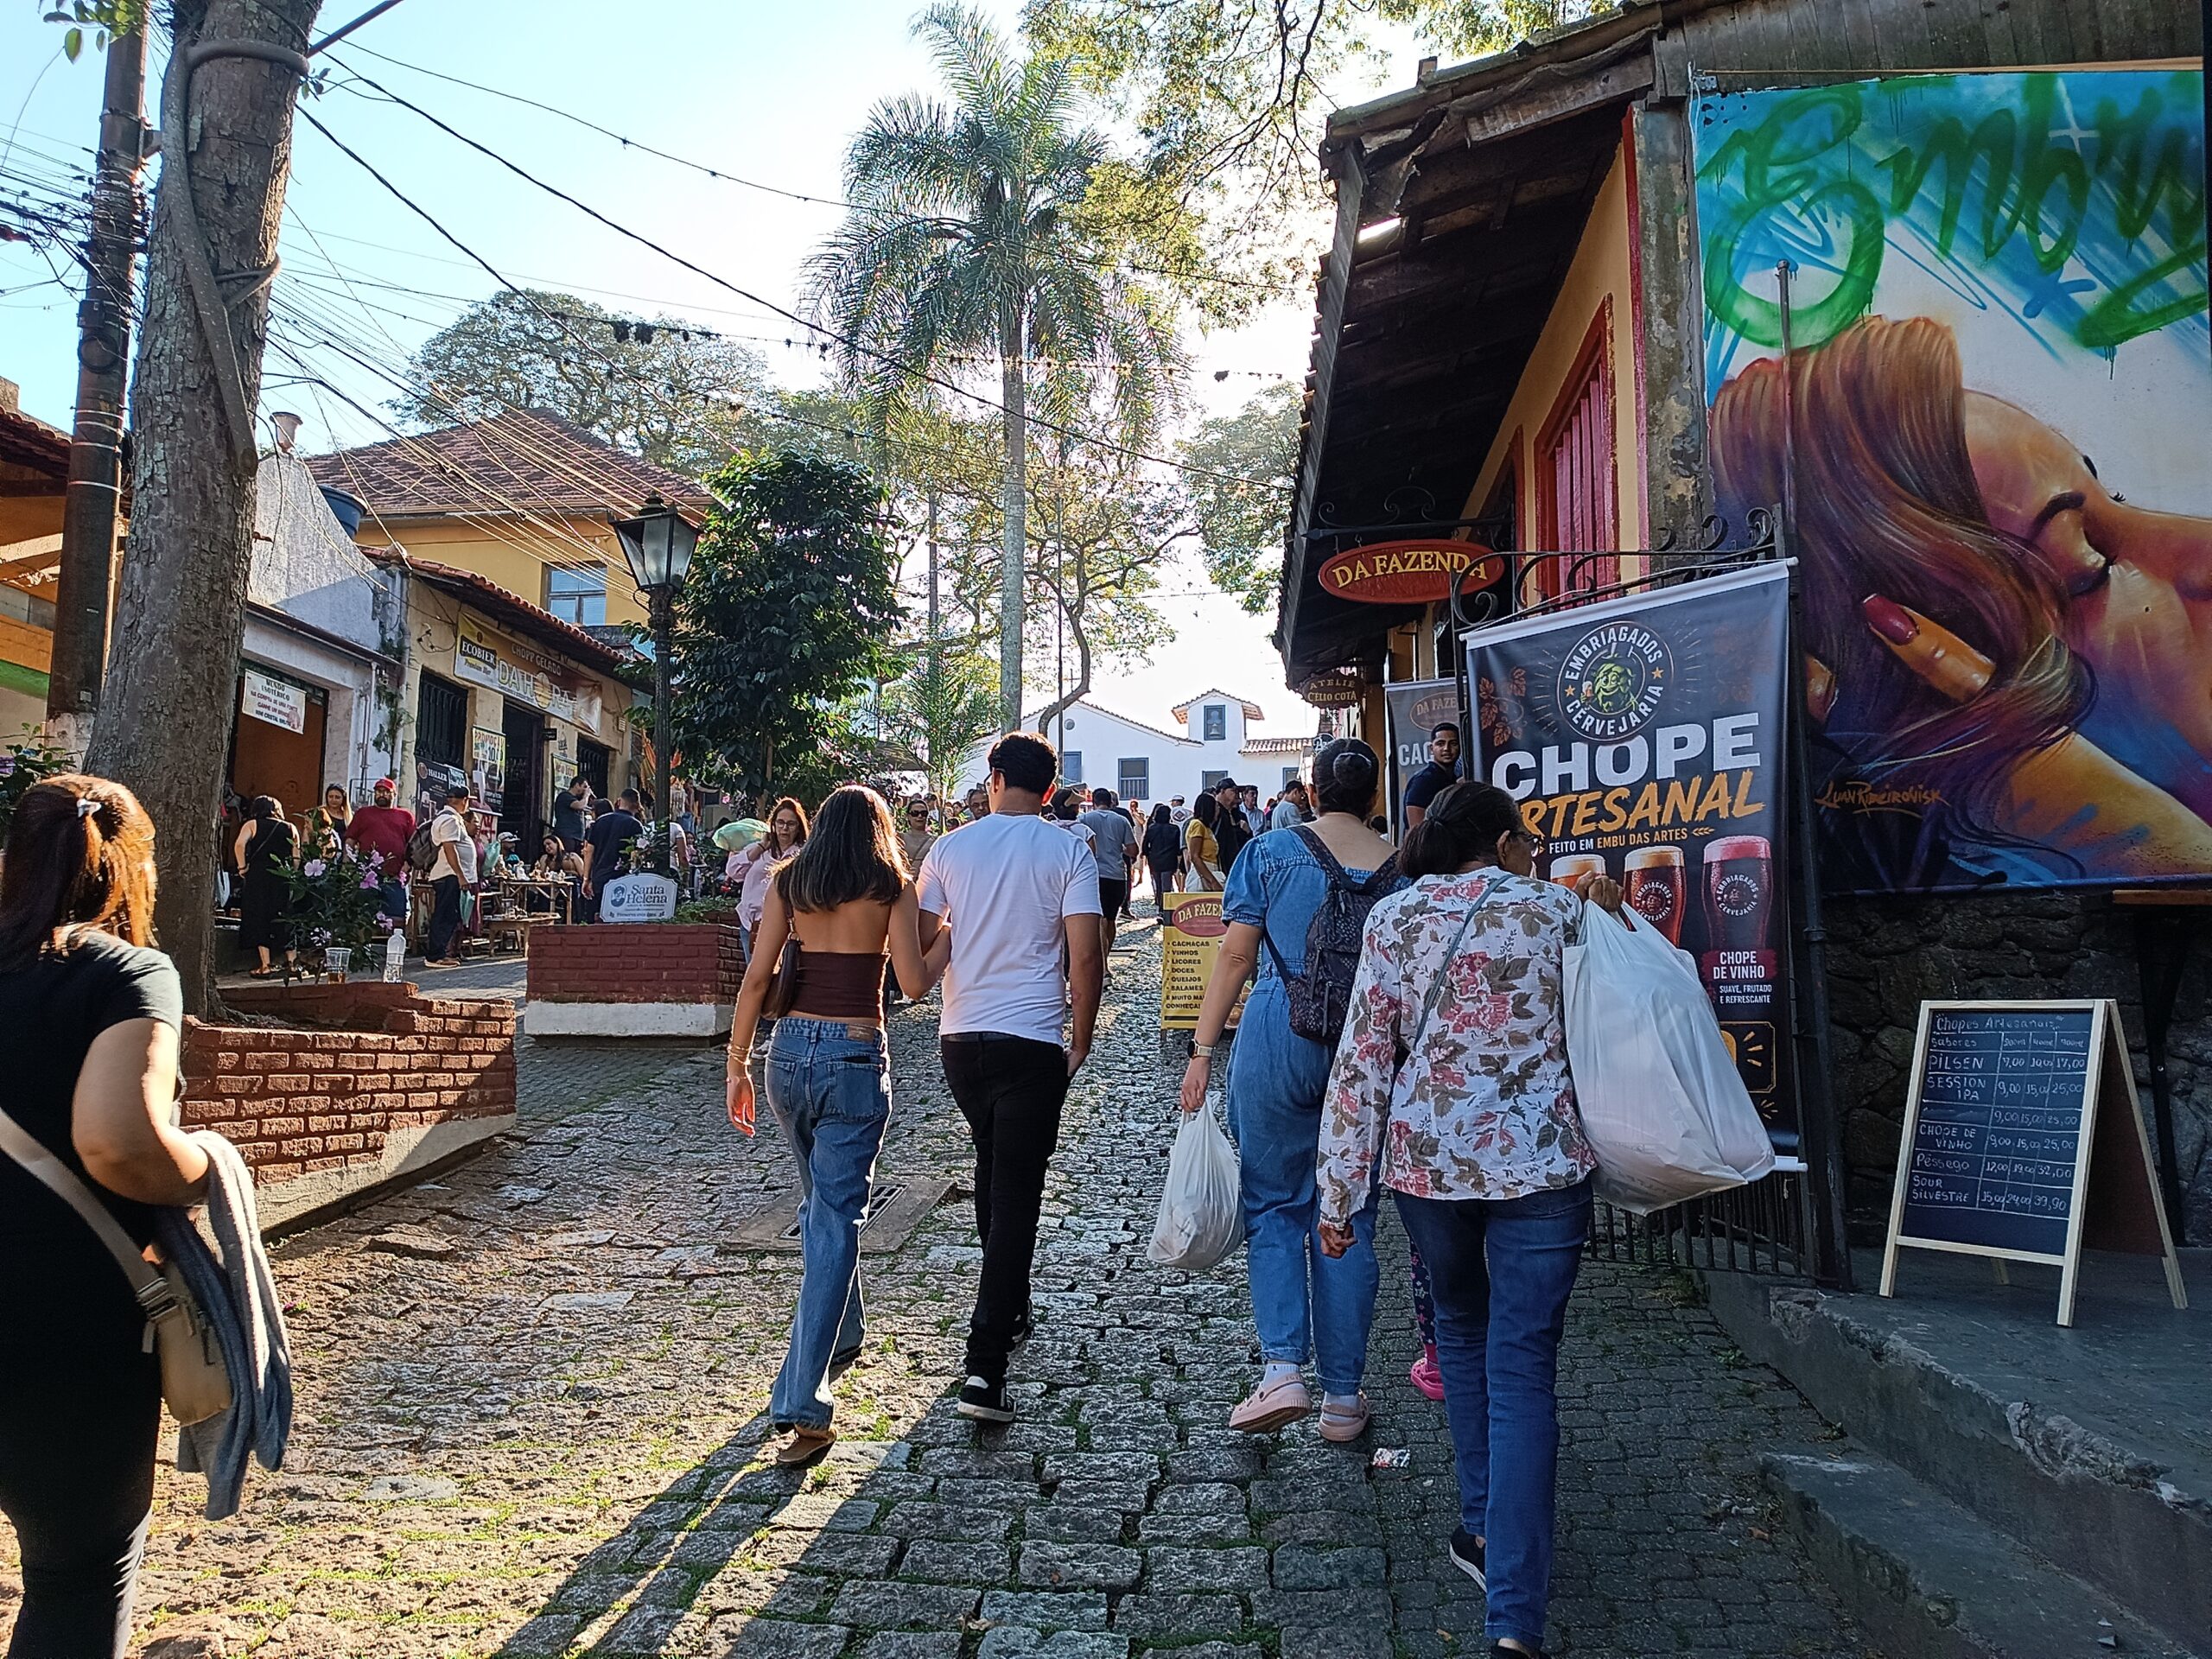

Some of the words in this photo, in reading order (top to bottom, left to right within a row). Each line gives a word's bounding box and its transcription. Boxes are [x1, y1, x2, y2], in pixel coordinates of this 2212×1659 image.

[1332, 560, 1372, 588] DA
[1373, 551, 1488, 580] FAZENDA
[462, 641, 496, 665] ECOBIER
[512, 644, 534, 663] CHOPP
[535, 655, 562, 677] GELADO
[1565, 626, 1663, 681] EMBRIAGADOS
[499, 659, 520, 691] DA
[1416, 702, 1429, 716] DA
[1566, 685, 1663, 735] CERVEJARIA
[1492, 713, 1761, 801] CHOPE
[1520, 769, 1766, 840] RTESANAL
[1549, 840, 1576, 855] FEITO
[1580, 838, 1594, 851] EM
[1597, 835, 1626, 849] EMBU
[1629, 832, 1650, 847] DAS
[1654, 828, 1688, 843] ARTES
[631, 884, 664, 894] Santa
[626, 893, 667, 904] Helena
[1179, 907, 1192, 924] DA
[1719, 951, 1757, 964] CHOPE
[1713, 966, 1727, 979] DE
[1730, 965, 1764, 979] VINHO
[1744, 984, 1772, 993] FRUTADO
[1726, 995, 1770, 1003] REFRESCANTE
[1936, 1016, 1979, 1033] Chopes
[1927, 1077, 1986, 1089] SESSION
[1998, 1082, 2021, 1097] 9,00
[1964, 1128, 1976, 1138] DE
[1990, 1135, 2012, 1147] 9,00
